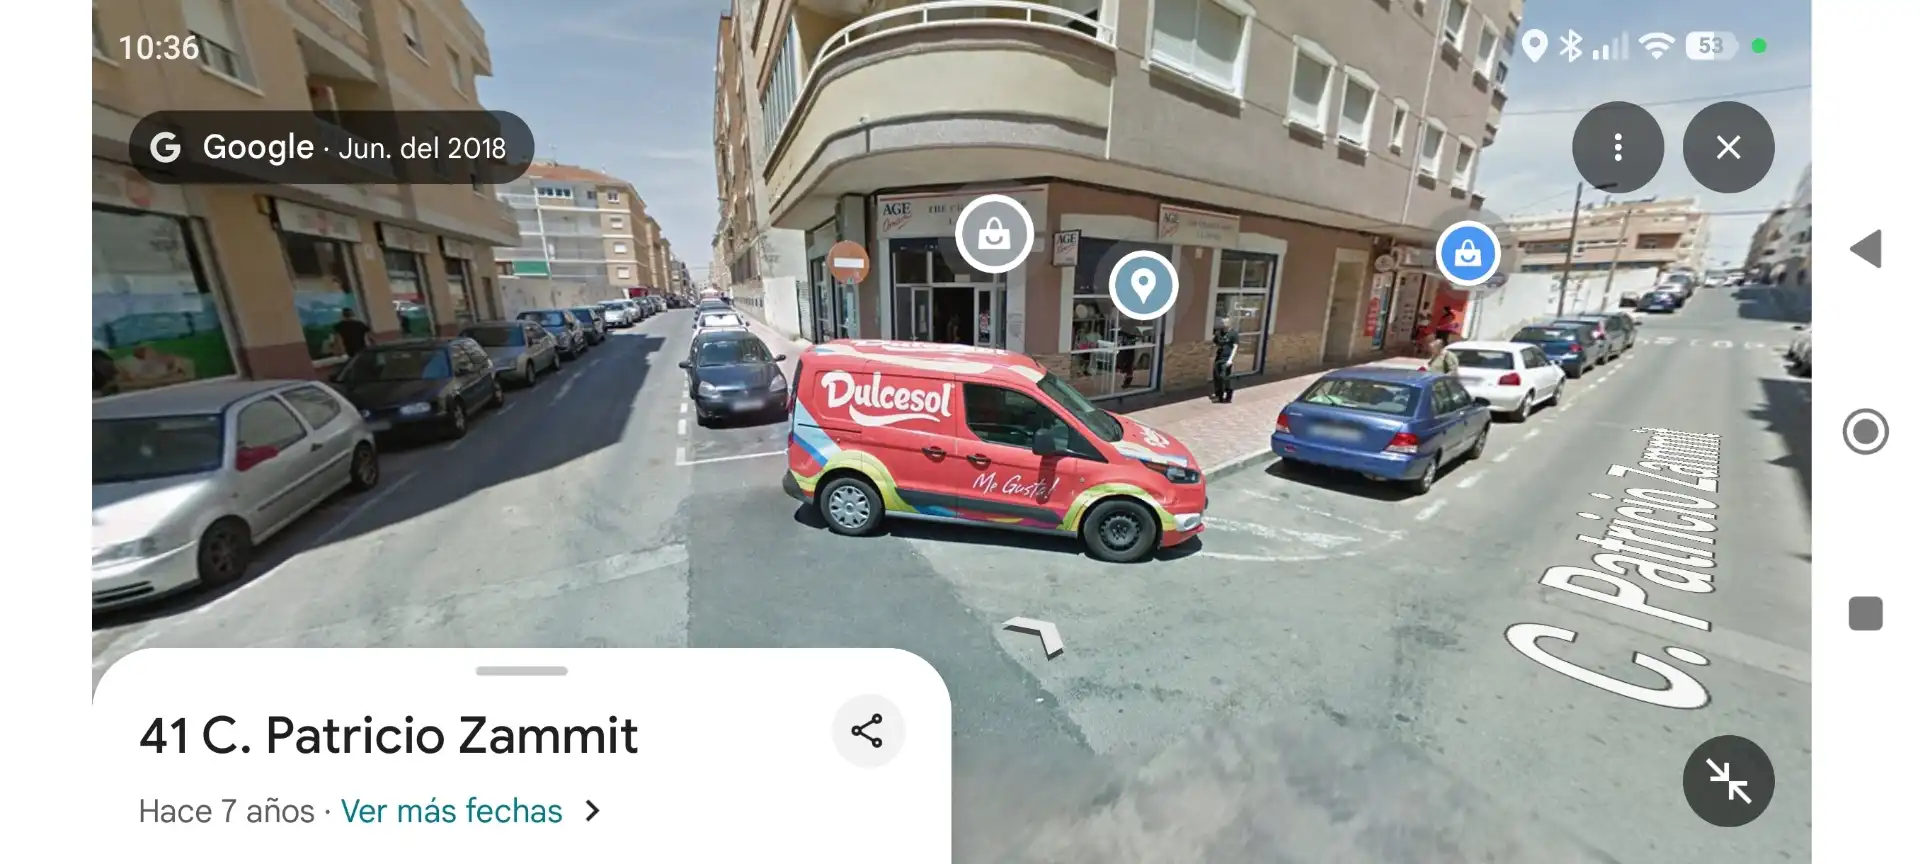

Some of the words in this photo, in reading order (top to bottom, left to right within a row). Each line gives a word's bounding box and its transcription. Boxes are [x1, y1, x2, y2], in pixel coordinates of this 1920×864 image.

[883, 202, 912, 216] AGE
[1057, 233, 1077, 244] AGE
[821, 369, 952, 417] Dulcesol
[972, 472, 998, 495] Me
[1002, 474, 1060, 499] Gusta!
